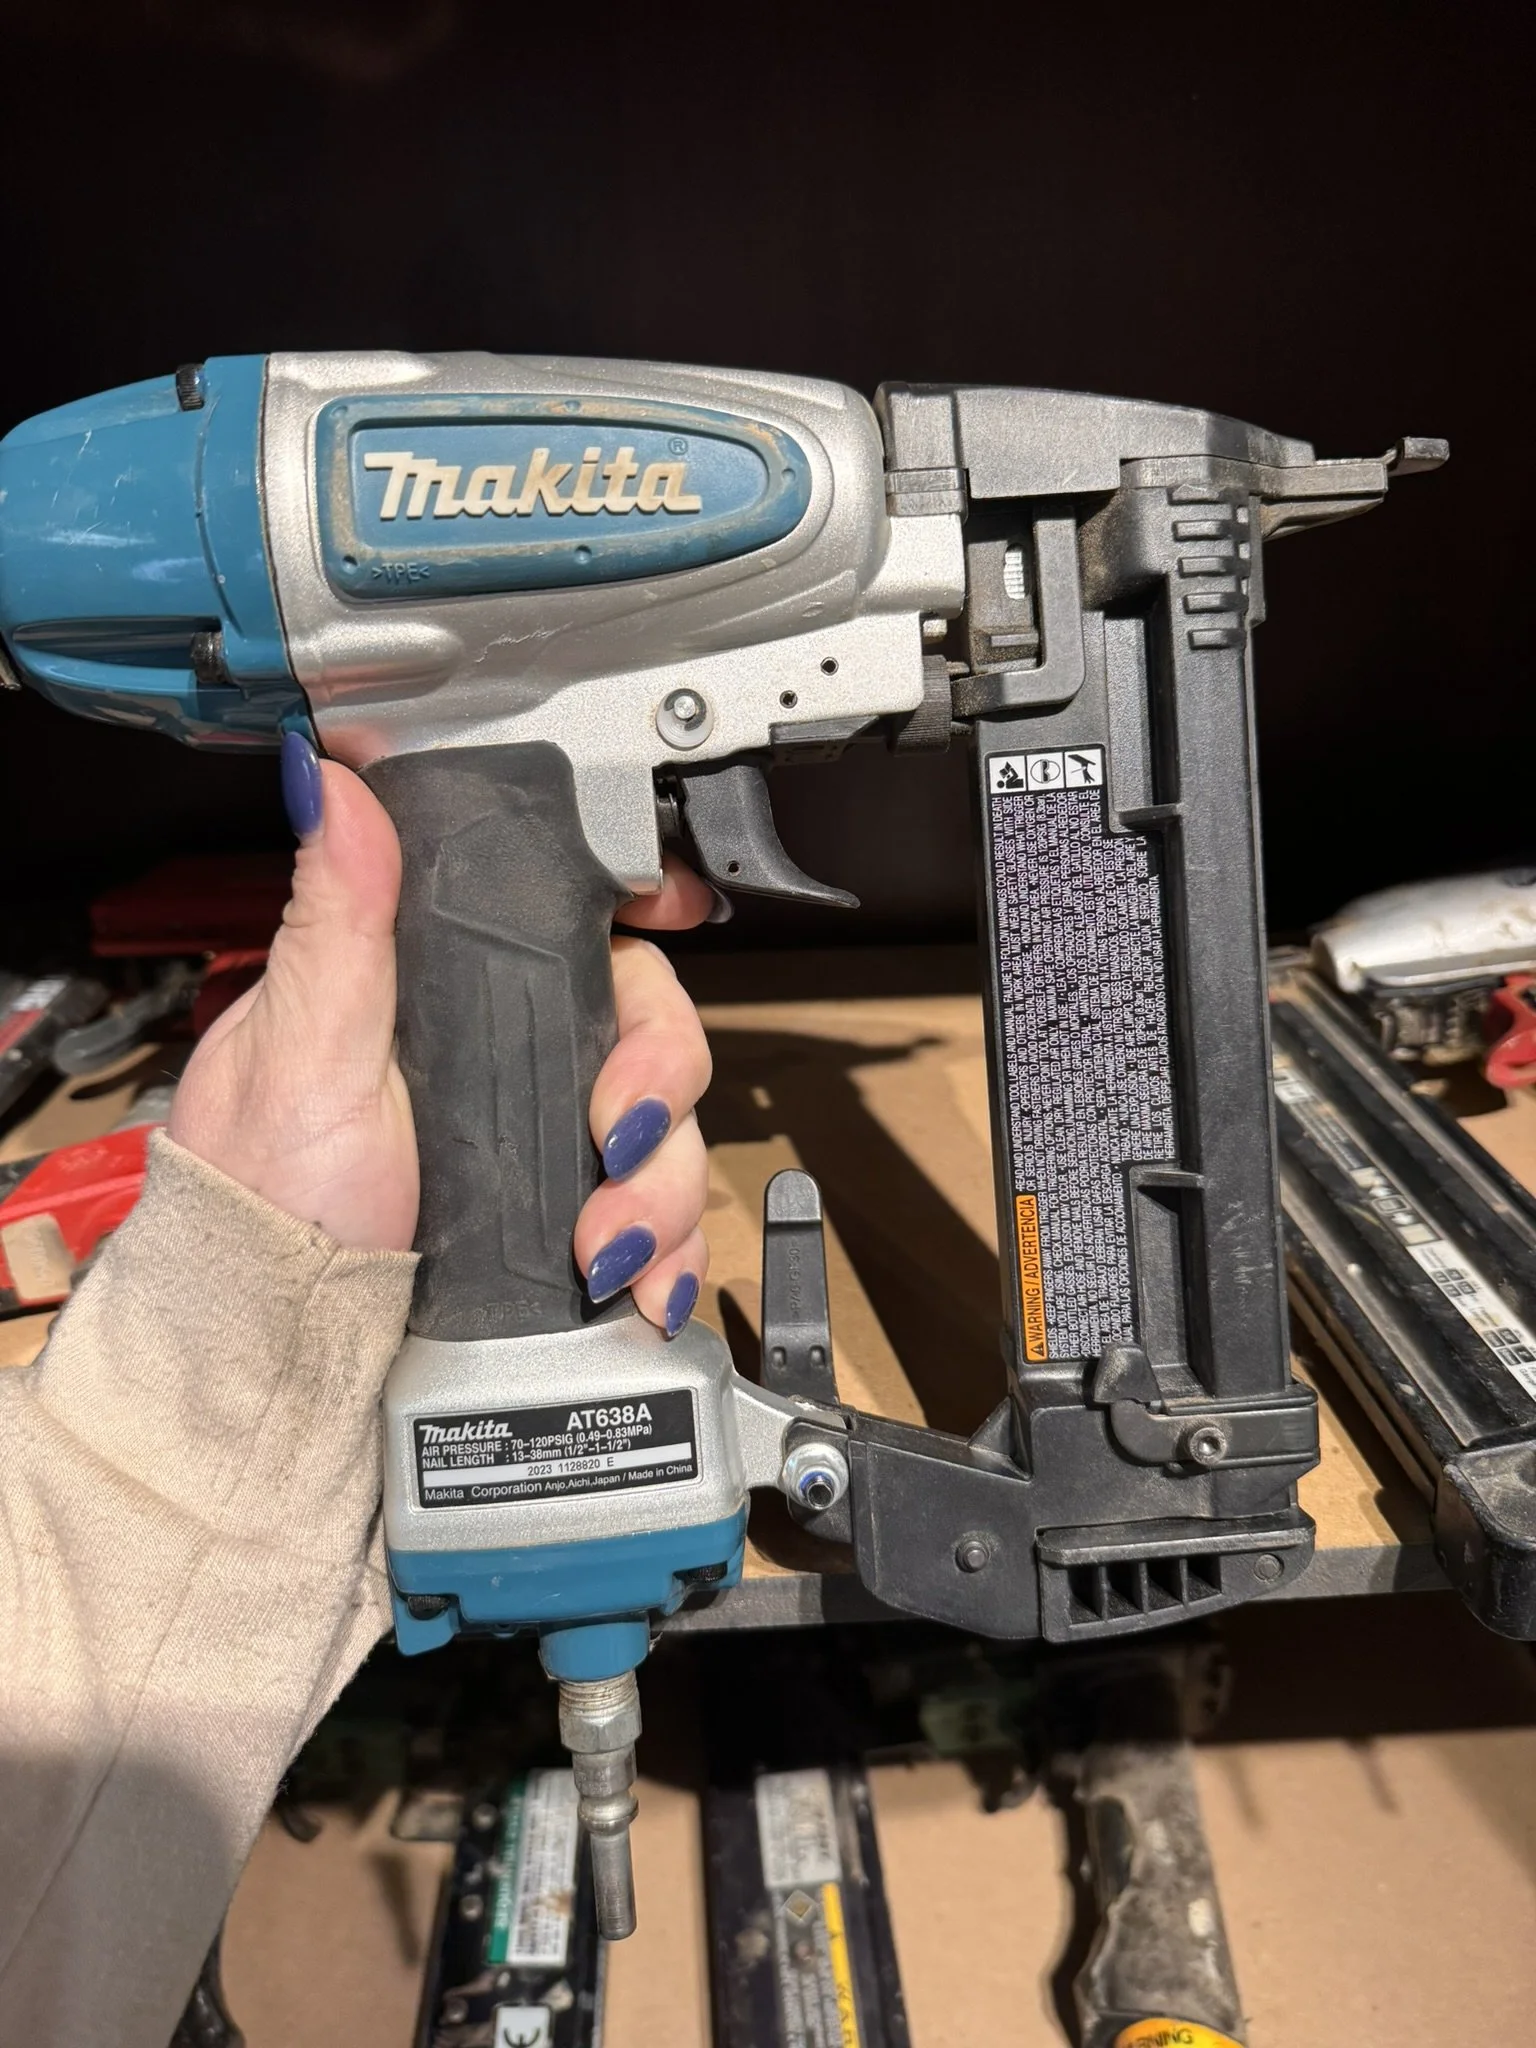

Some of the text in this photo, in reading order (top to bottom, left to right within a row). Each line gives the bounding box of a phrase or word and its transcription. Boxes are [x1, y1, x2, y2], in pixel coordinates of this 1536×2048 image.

[1013, 794, 1024, 828] TRIGGER
[1025, 807, 1036, 839] OXYGEN
[1079, 801, 1090, 841] CONSULTE
[1016, 830, 1025, 851] WHAT
[1037, 823, 1047, 852] 120PSIG
[1017, 852, 1028, 902] UNDERSTAND
[1039, 865, 1050, 904] PRESSURE
[1020, 903, 1030, 919] AND
[1031, 910, 1041, 933] WORK
[1021, 920, 1031, 944] KNOW
[1043, 920, 1054, 962] OPERATING
[1086, 912, 1098, 973] ACCIONAMIENTO
[1033, 943, 1044, 974] OTHERS
[1045, 964, 1055, 983] SAFE
[992, 796, 1024, 1168] AND UNDERSTAND TOOL LABELS AND FAILURE FOLLOW WARNINGS COULD RESULT DEATH
[1003, 795, 1035, 1177] SERIOUS AND OTHERS WORK AREA MUST WEAR SAFETY GLASSES WITH SIDE
[1104, 849, 1129, 1120] NUNCA OTROS GASES PUEDE ESTO
[1126, 843, 1152, 1148] AIRE SEGURA 120PSIG DESCONECTE MANGUERA AIRE
[1026, 995, 1037, 1040] ACCIDENTAL
[1036, 990, 1047, 1026] YOURSELF
[1047, 984, 1057, 1020] MAXIMUM
[1057, 790, 1093, 1244] ADVERTENCIAS RESULTAR LESIONES GRAVES OPERADORES PERSONAS ALREDEDOR
[1068, 789, 1103, 1226] USAR GAFAS PROTECTORAS PROTECTOR MANTENGA DEDOS ALEJADOS GATILLO ESTAR
[1090, 987, 1101, 1019] SISTEMA
[1093, 848, 1121, 1164] NUNCA APUNTE HERRAMIENTA USTED MISMO OTRAS PERSONAS ALREDEDOR
[1137, 851, 1164, 1159] RETIRE CLAVOS ANTES HACER REALIZAR SERVICIO SOBRE
[1047, 815, 1083, 1254] REMOVE NAILS BEFORE WHEN COMPRENDA ETIQUETAS MANUAL
[1092, 1021, 1102, 1041] CUAL
[1153, 939, 1171, 1104] DESPEJAR CLAVOS ATASCADOS USAR
[1039, 1038, 1049, 1058] TOOL
[1094, 1042, 1104, 1079] ENTIENDA
[1120, 930, 1142, 1160] GENERE AIRE SECO REGULADO
[1041, 1060, 1051, 1082] POINT
[1051, 1060, 1063, 1104] REGULATED
[1031, 1075, 1042, 1118] FASTENERS
[1096, 1088, 1106, 1108] SEPA
[1034, 1119, 1044, 1149] DRIVING
[1037, 1167, 1047, 1190] WHEN
[1046, 1145, 1058, 1190] TRIGGERING
[1101, 1163, 1112, 1204] DESCARGA
[1038, 1190, 1049, 1223] TRIGGER
[1050, 1209, 1061, 1240] MANUAL
[1019, 1198, 1039, 1279] ADVERTENCIA
[1041, 1224, 1051, 1247] FROM
[1062, 1219, 1073, 1261] EXPLOSION
[1105, 1216, 1115, 1243] EVITAR
[1025, 1287, 1043, 1341] WARNING
[567, 1403, 652, 1432] AT638A
[421, 1445, 440, 1458] AIR
[441, 1441, 501, 1456] PRESSURE
[422, 1457, 447, 1469] NAIL
[450, 1454, 495, 1468] LENGTH
[527, 1464, 552, 1477] 2023
[606, 1456, 615, 1467] E
[424, 1488, 465, 1501] Makita
[471, 1481, 542, 1500] Corporation
[628, 1468, 654, 1481] Made
[656, 1466, 664, 1477] in
[666, 1462, 693, 1475] China
